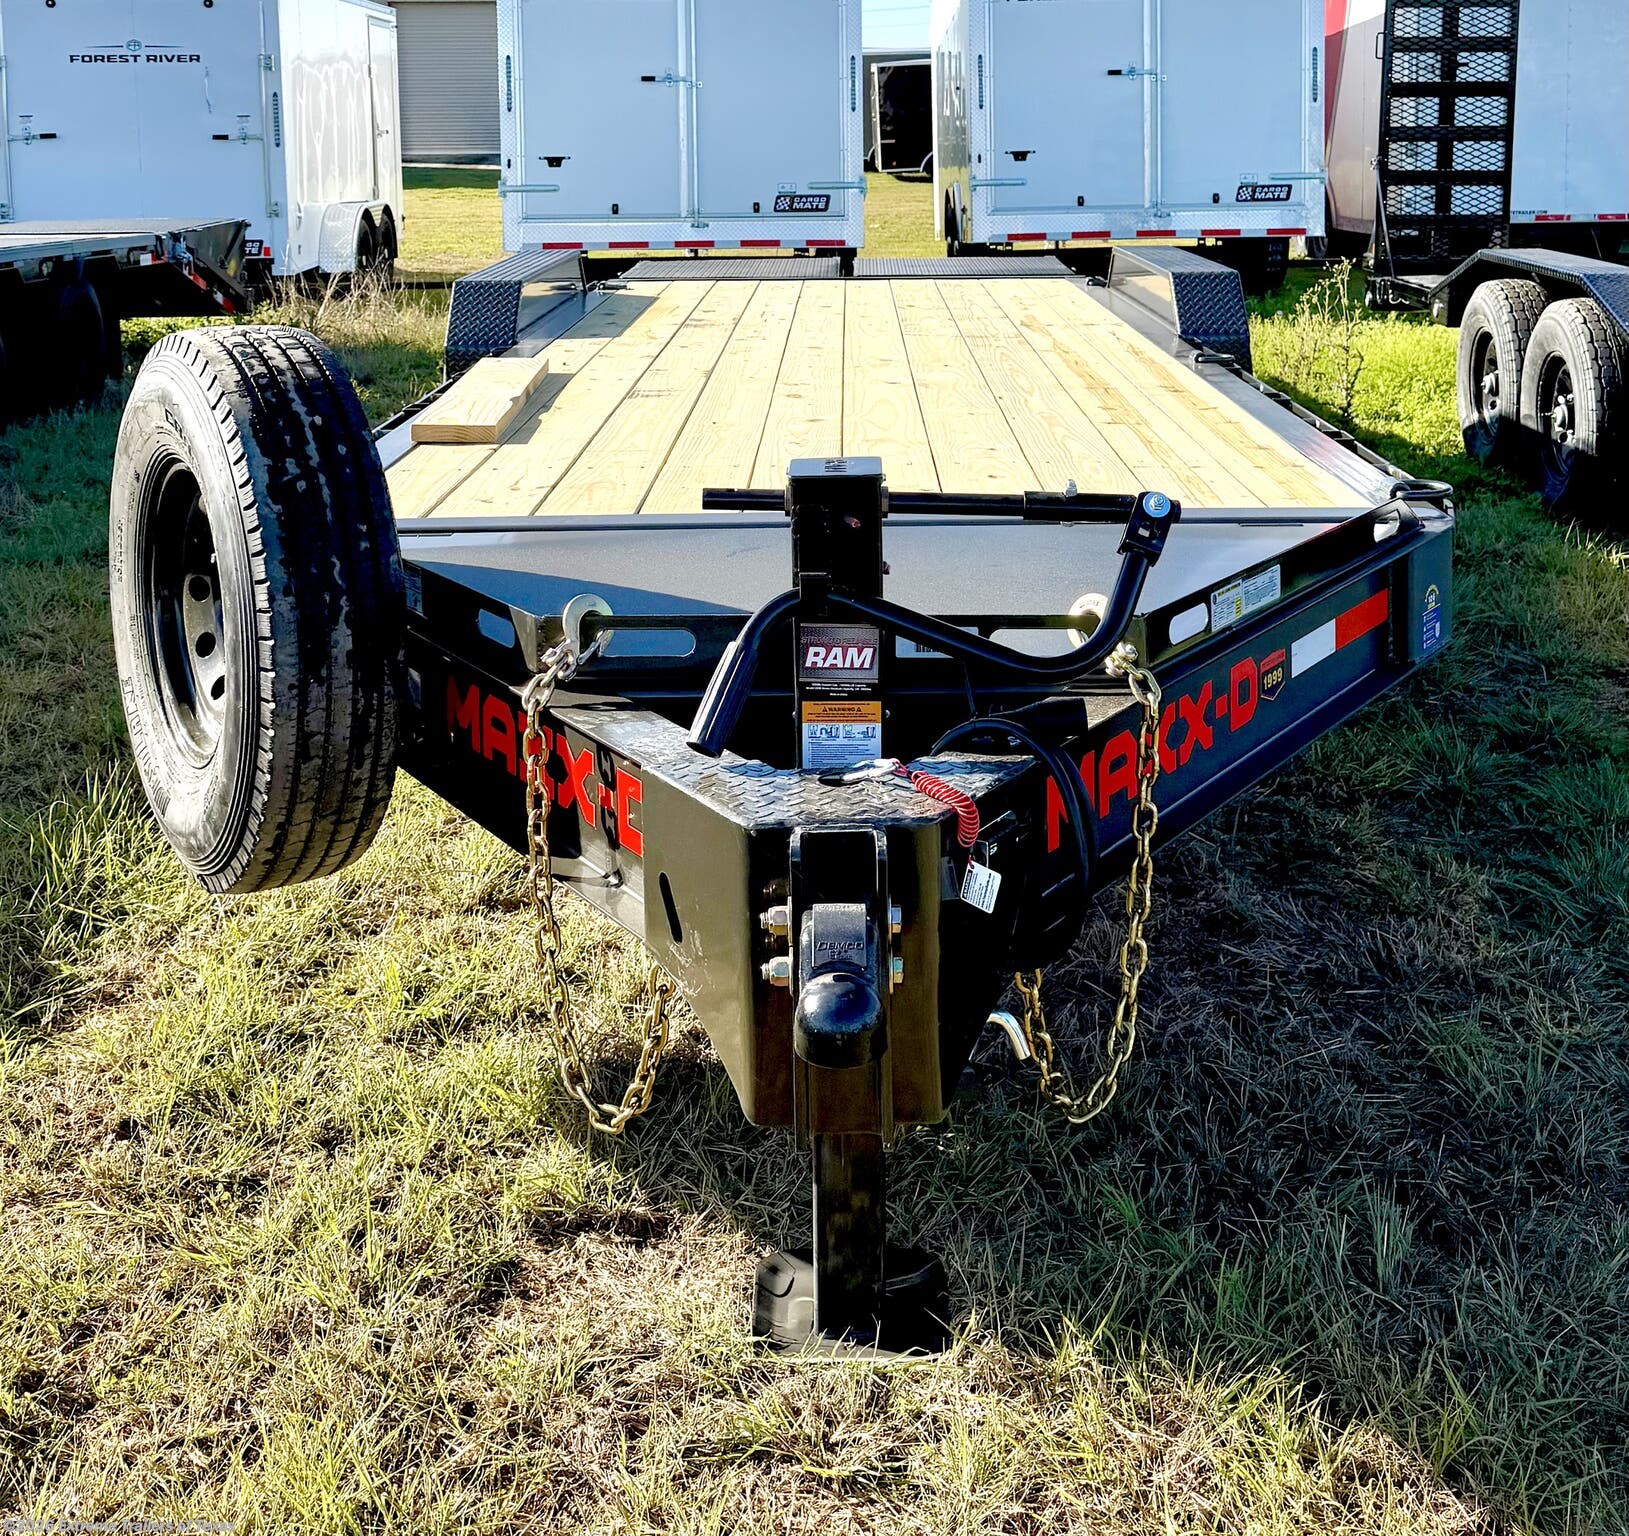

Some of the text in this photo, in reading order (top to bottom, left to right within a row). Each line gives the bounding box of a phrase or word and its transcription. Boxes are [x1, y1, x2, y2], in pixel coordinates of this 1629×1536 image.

[69, 54, 201, 64] FOREST RIVER
[804, 646, 875, 669] RAM
[1263, 667, 1283, 690] 1999
